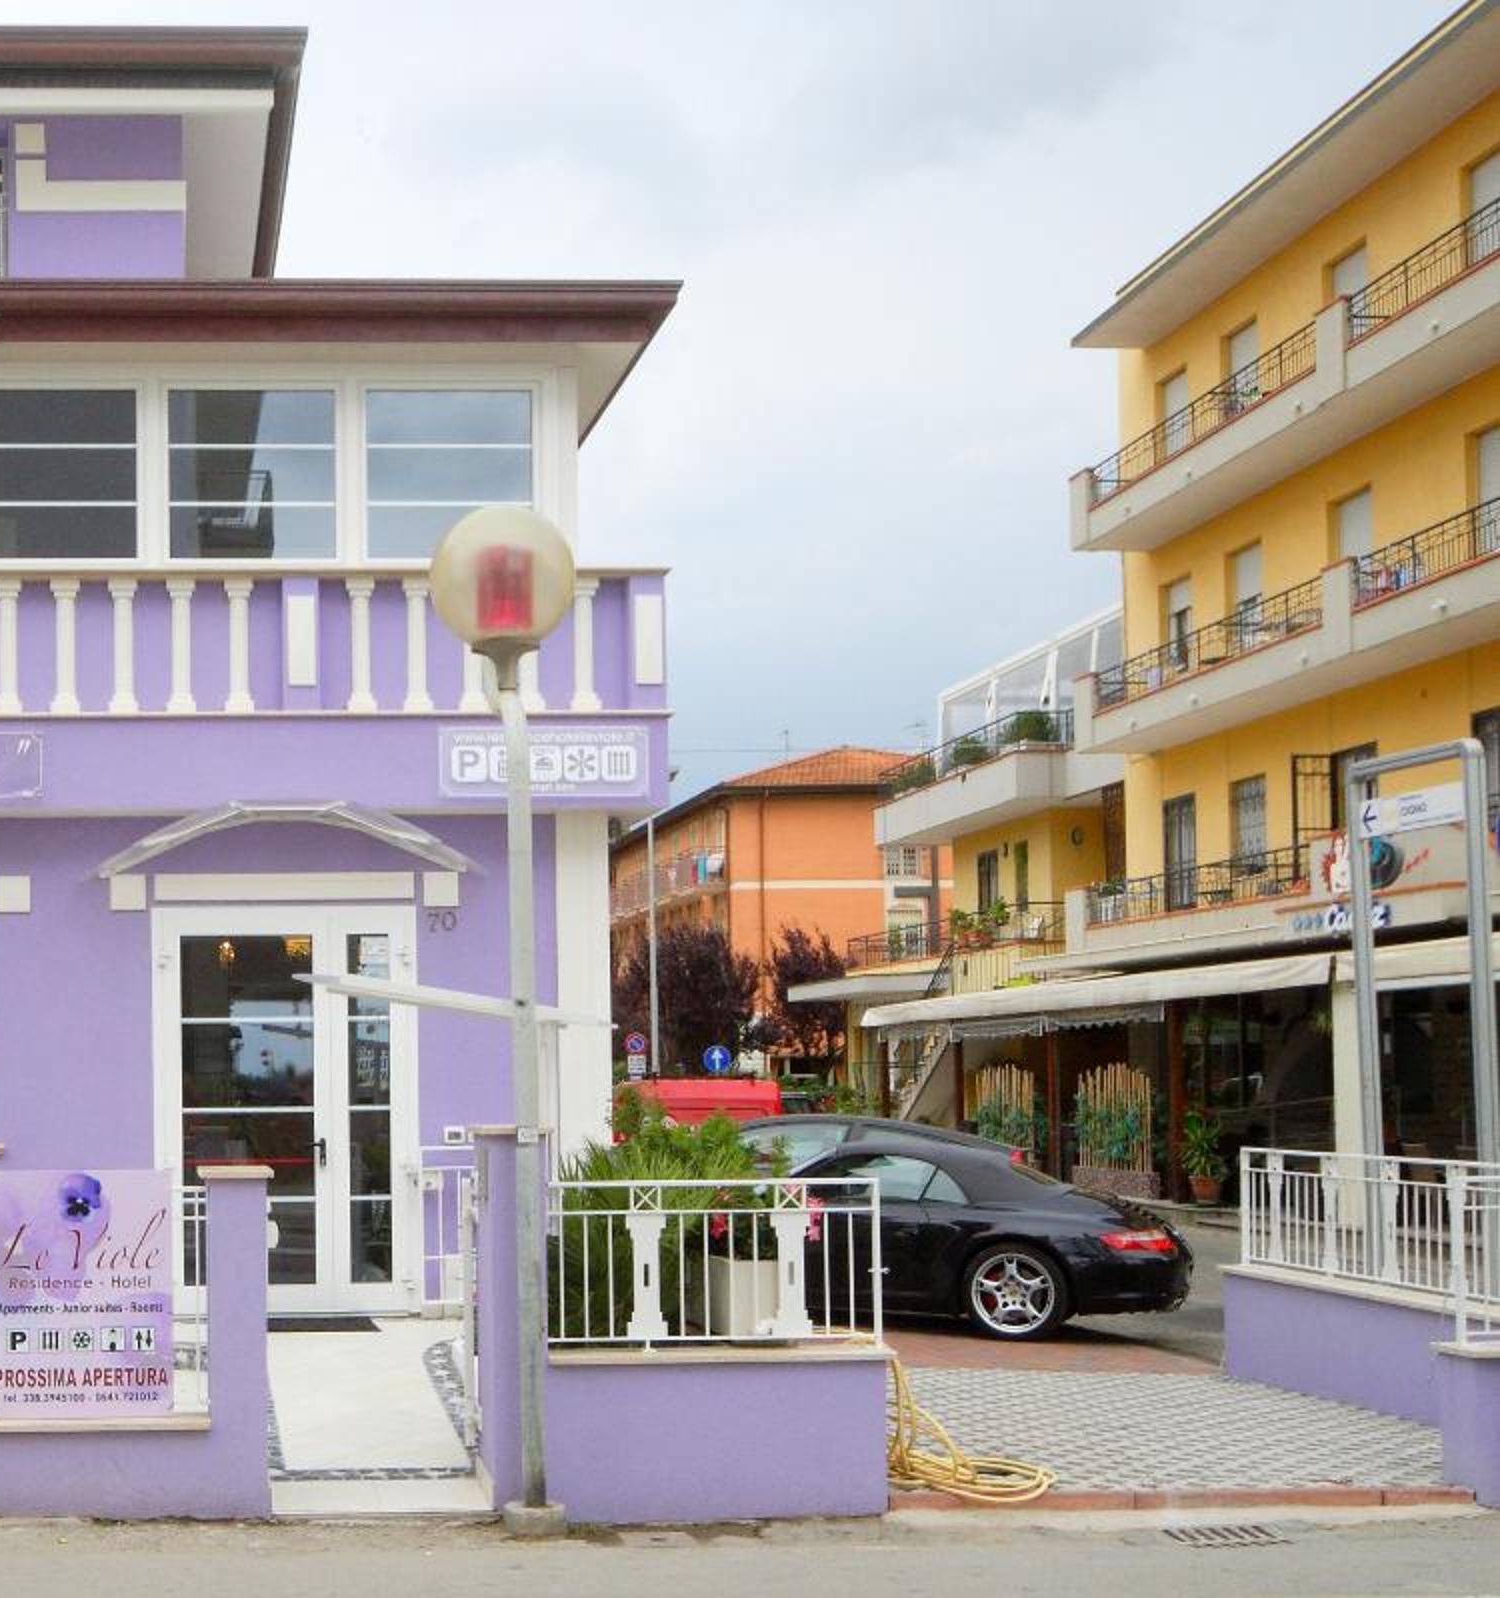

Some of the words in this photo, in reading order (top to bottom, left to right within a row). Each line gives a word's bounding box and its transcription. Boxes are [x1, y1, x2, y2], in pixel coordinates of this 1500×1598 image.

[459, 750, 479, 777] P
[427, 911, 458, 933] 70
[67, 1206, 168, 1272] Viole
[8, 1277, 94, 1290] Residence
[110, 1274, 152, 1290] Hotel
[9, 1331, 27, 1351] P
[81, 1367, 169, 1388] APERTURA
